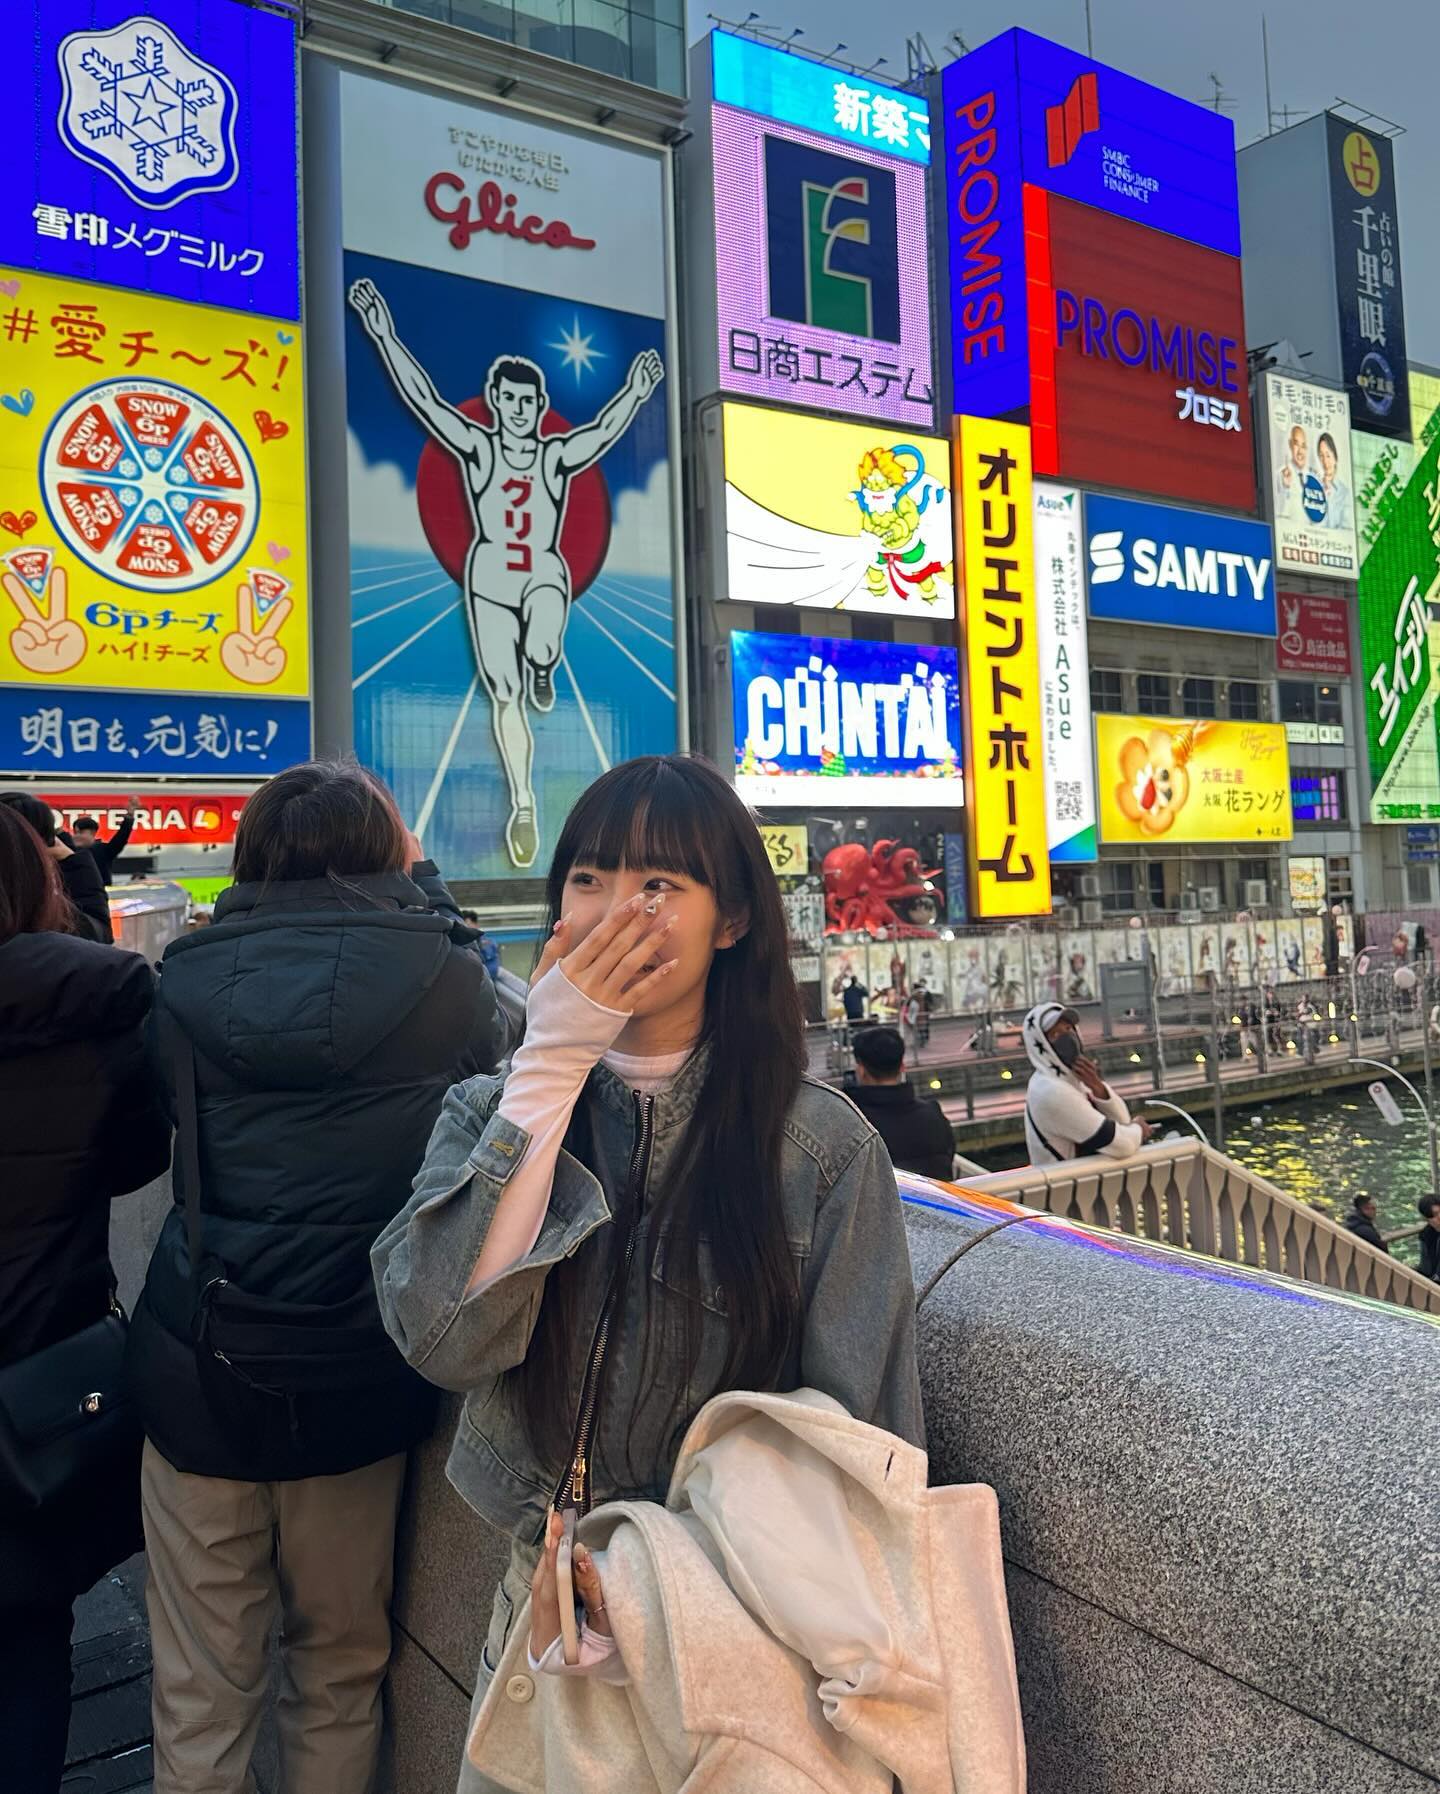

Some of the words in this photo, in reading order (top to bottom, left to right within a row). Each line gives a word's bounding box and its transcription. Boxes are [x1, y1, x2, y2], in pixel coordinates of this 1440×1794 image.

[1102, 145, 1130, 168] SMBC
[424, 171, 596, 250] Glico
[955, 91, 1006, 365] PROMISE
[33, 203, 264, 276] 雪印メグミルク
[729, 328, 933, 404] 日商エステム
[1056, 288, 1240, 394] PROMISE
[64, 411, 100, 460] SNOW
[128, 397, 180, 418] SNOW
[1175, 387, 1242, 431] プロミス
[204, 433, 240, 479] SNOW
[62, 493, 101, 541] SNOW
[207, 510, 239, 557] SNOW
[502, 475, 534, 573] グリコ
[127, 555, 180, 574] SNOW
[1132, 538, 1272, 601] SAMTY
[978, 448, 1035, 883] オリエントホーム
[747, 656, 948, 761] CHINTAI
[1225, 789, 1286, 814] 花ラング
